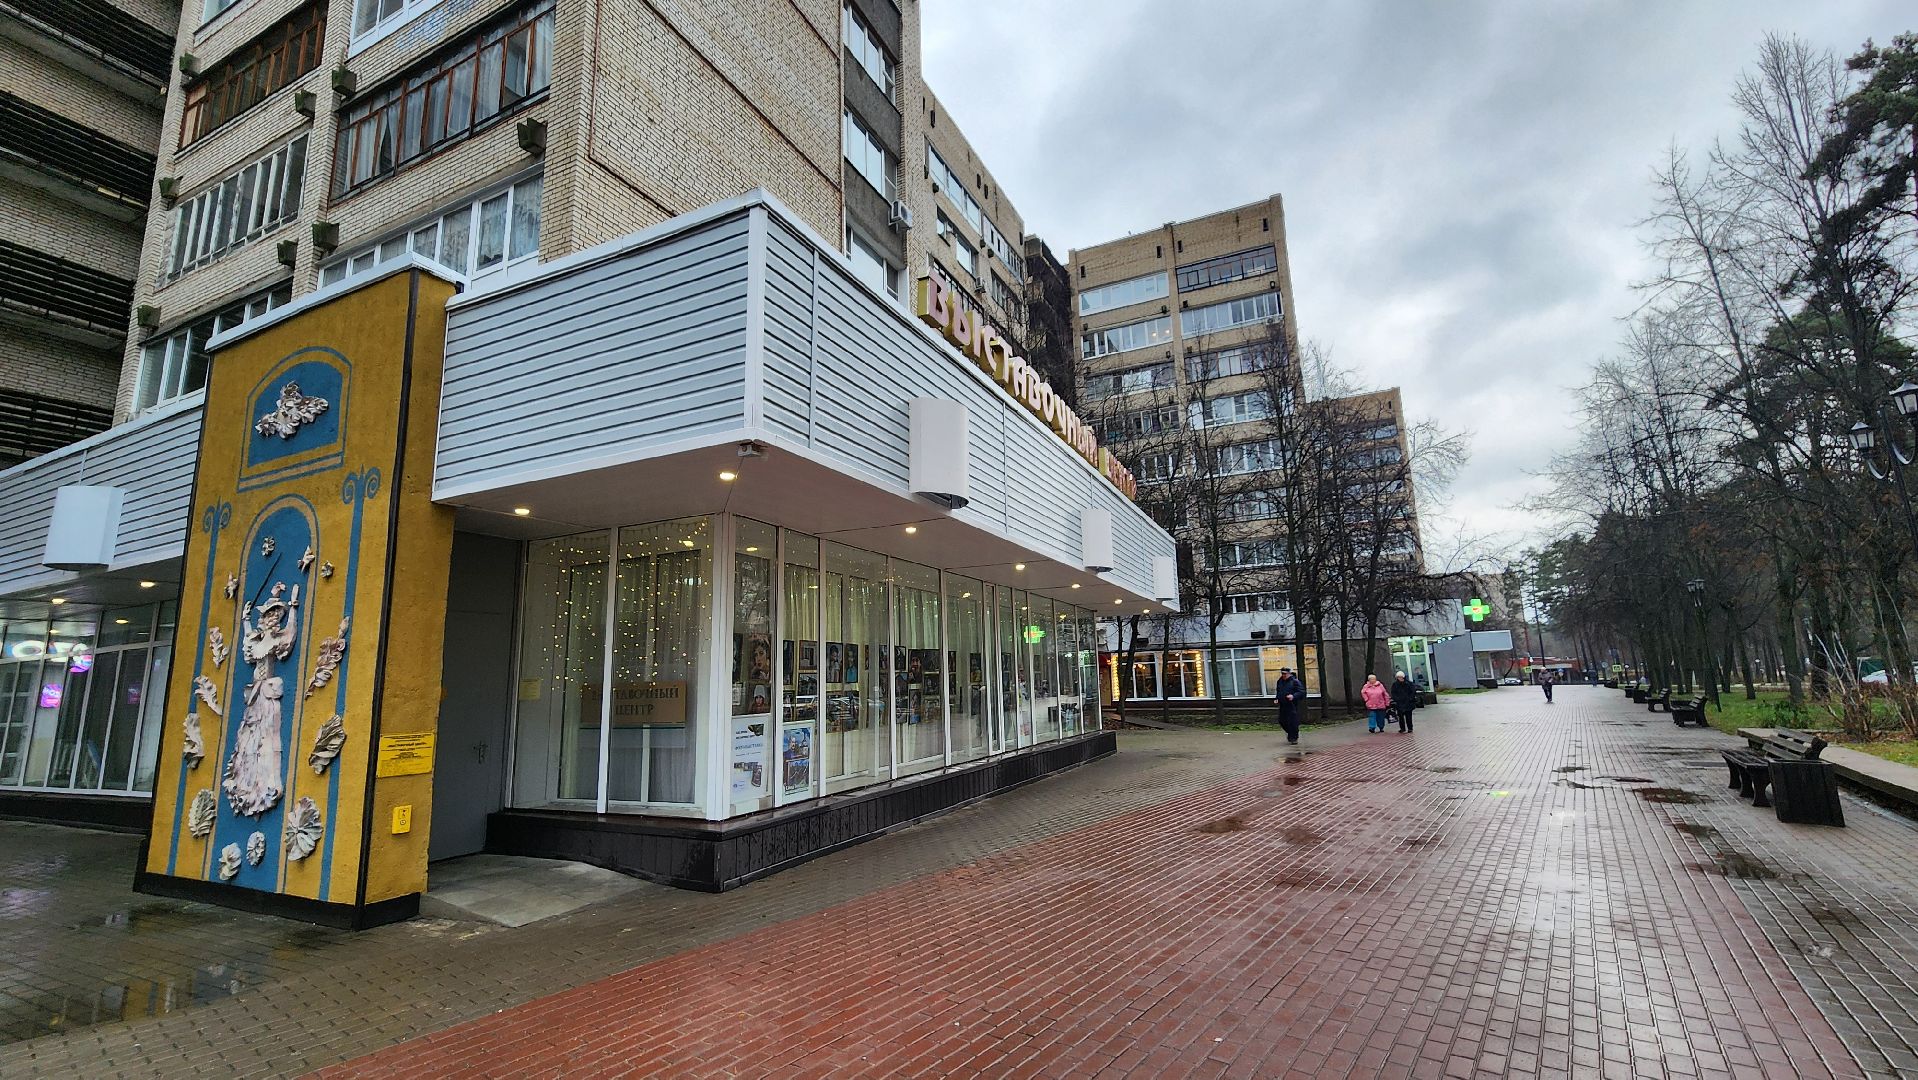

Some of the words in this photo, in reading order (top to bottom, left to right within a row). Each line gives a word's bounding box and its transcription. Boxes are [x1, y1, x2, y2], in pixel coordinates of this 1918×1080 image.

[918, 269, 1098, 468] ВЫСТАВОЧНЫЙ
[592, 686, 678, 700] ВТАВОЧНЫЙ
[615, 704, 653, 716] ЦЕНТР
